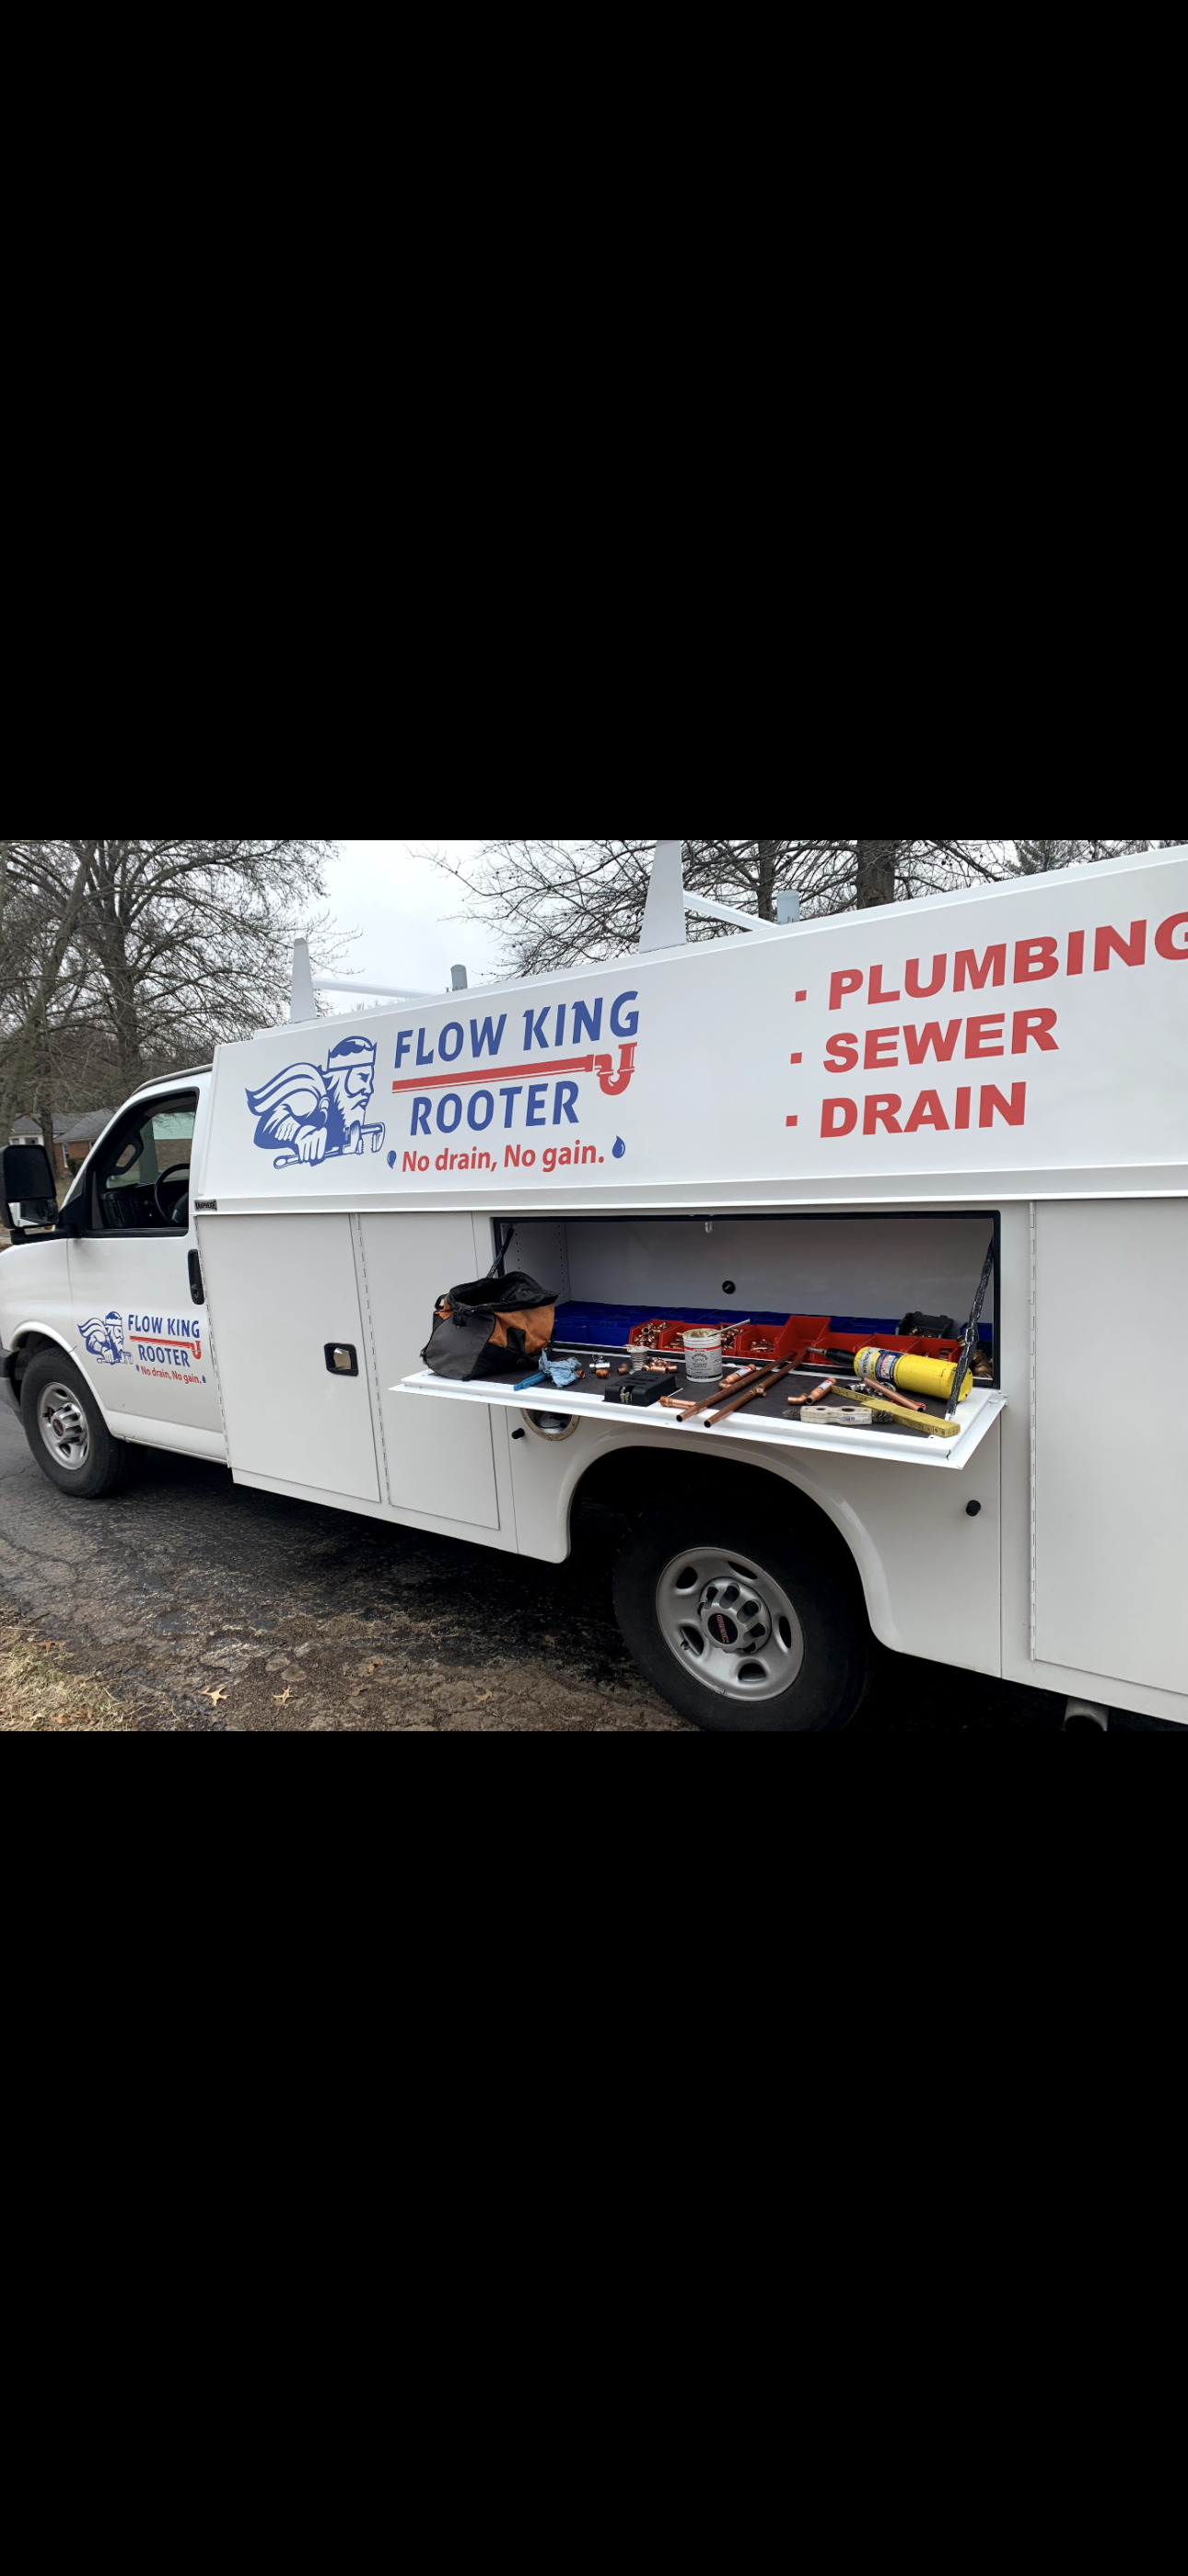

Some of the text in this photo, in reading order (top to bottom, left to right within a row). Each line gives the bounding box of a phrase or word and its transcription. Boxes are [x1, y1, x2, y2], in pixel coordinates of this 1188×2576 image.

[829, 911, 1188, 1011] PLUMBING
[393, 990, 640, 1069] FLOW KING
[822, 1007, 1059, 1073] SEWER
[410, 1080, 579, 1136] ROOTER
[820, 1081, 1027, 1139] DRAIN
[402, 1144, 605, 1173] No drain, No gain.
[127, 1314, 200, 1339] FLOW KING
[137, 1344, 191, 1367] ROOTER
[140, 1365, 202, 1385] No drain, No gain.
[716, 1614, 729, 1644] GMC
